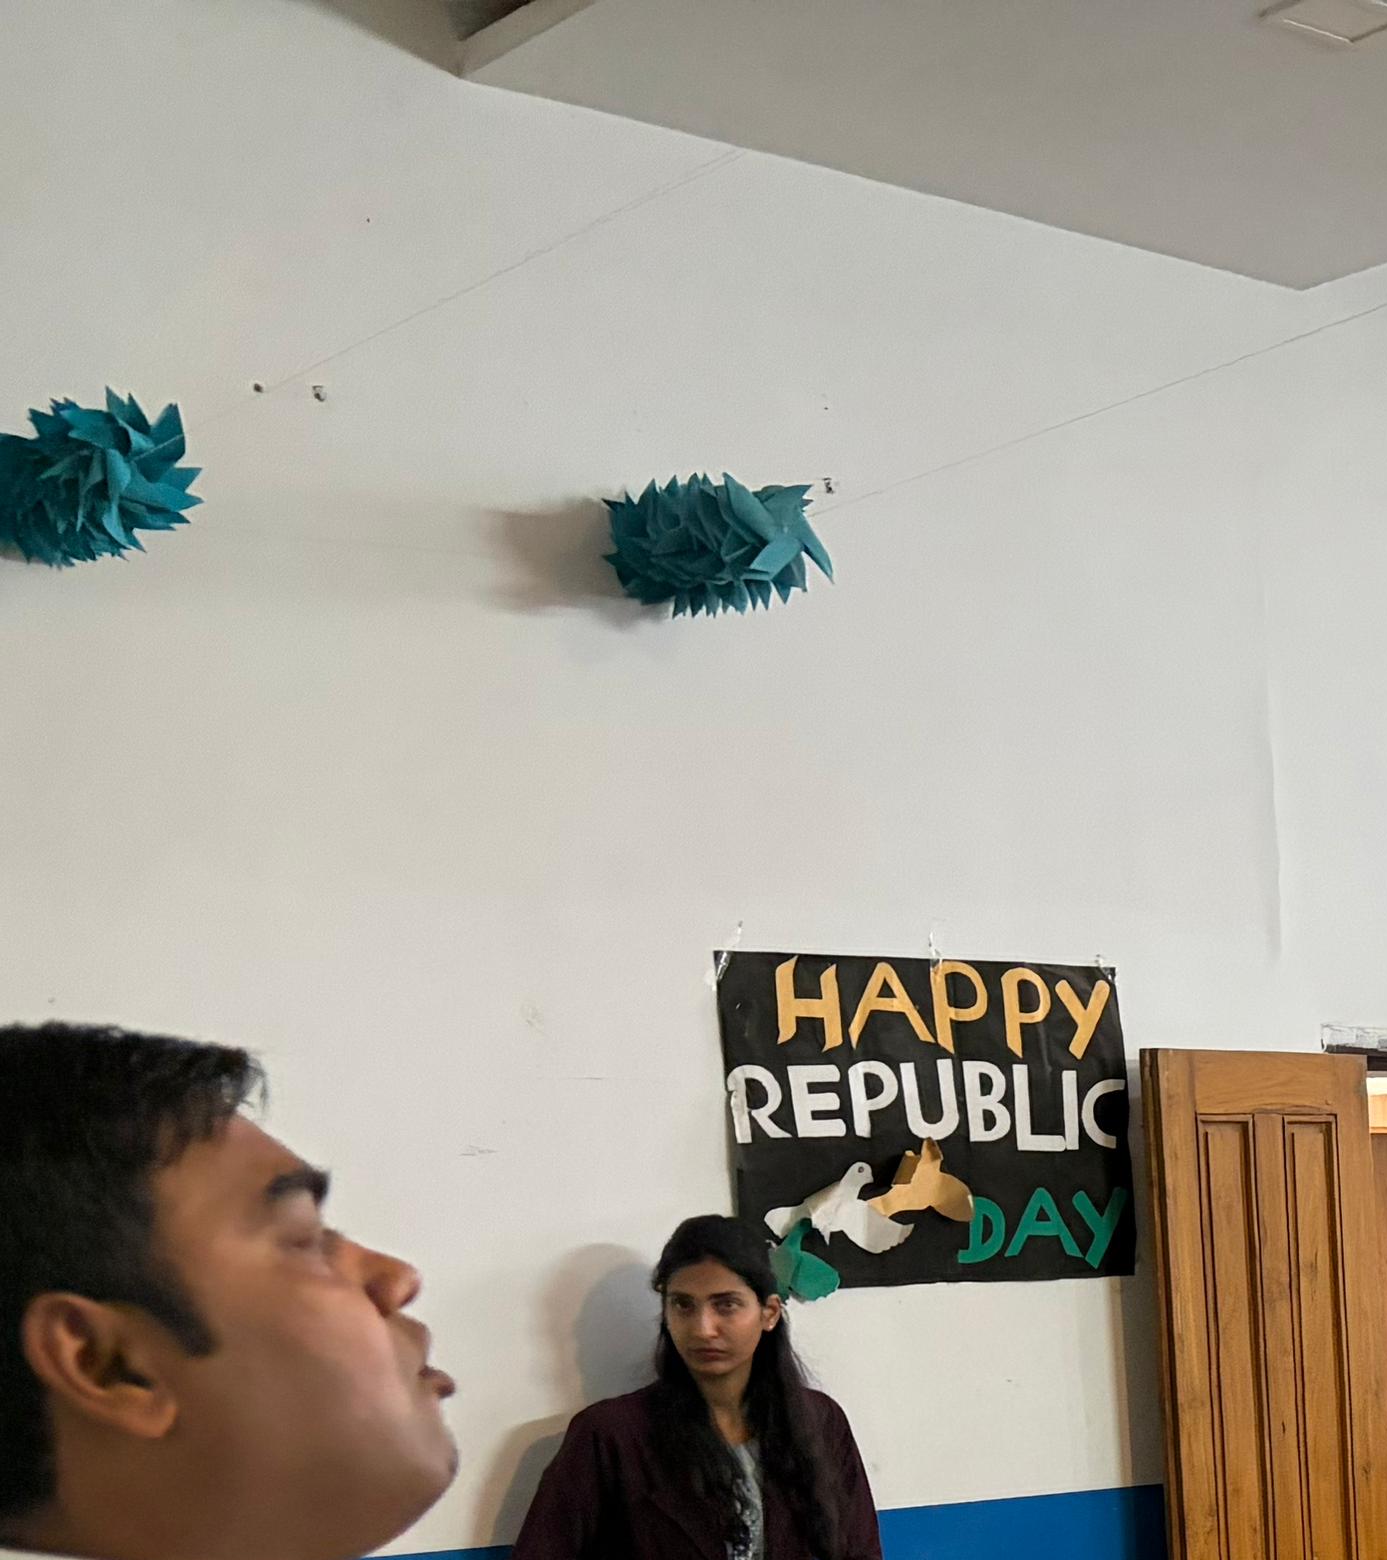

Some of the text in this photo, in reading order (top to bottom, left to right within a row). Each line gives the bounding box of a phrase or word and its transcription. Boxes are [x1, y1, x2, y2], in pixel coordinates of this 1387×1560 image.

[775, 955, 1110, 1059] HAPPY
[727, 1058, 1125, 1152] REPUBLIC
[958, 1187, 1127, 1269] DAY
